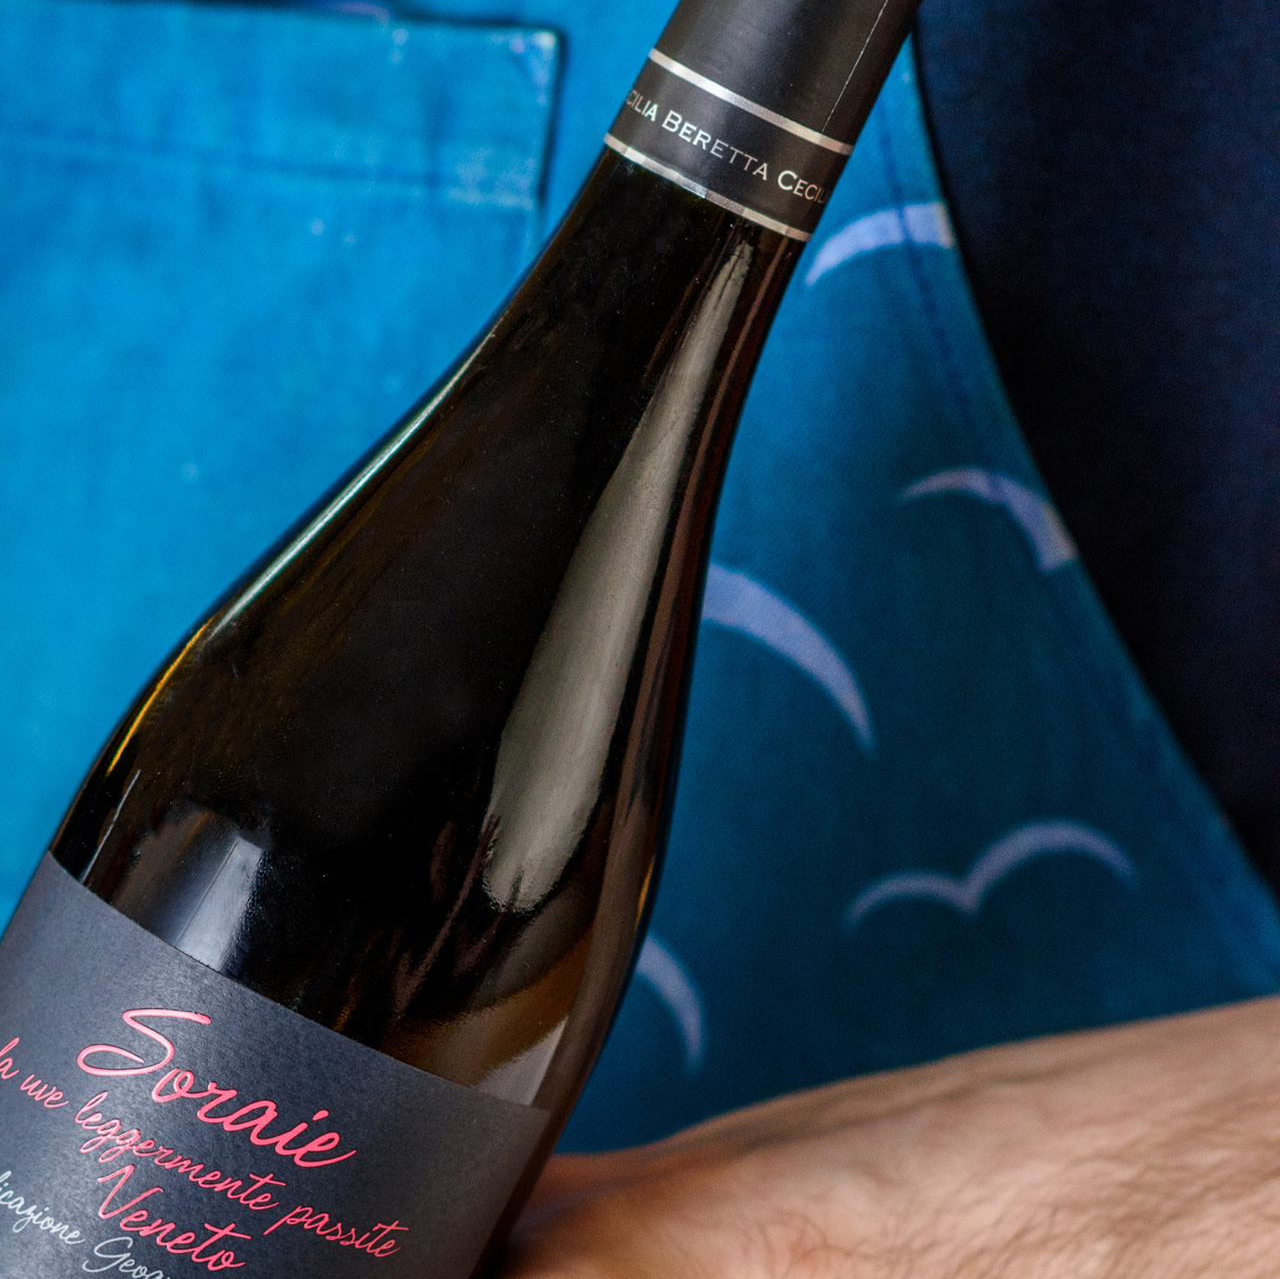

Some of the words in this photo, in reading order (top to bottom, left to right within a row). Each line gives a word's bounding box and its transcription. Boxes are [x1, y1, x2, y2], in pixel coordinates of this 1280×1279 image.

[625, 88, 659, 123] CILIA
[77, 1009, 356, 1167] Soraie
[20, 1074, 67, 1107] uve
[75, 1092, 285, 1209] leggermente
[263, 1205, 408, 1257] passite
[97, 1165, 250, 1270] Veneto
